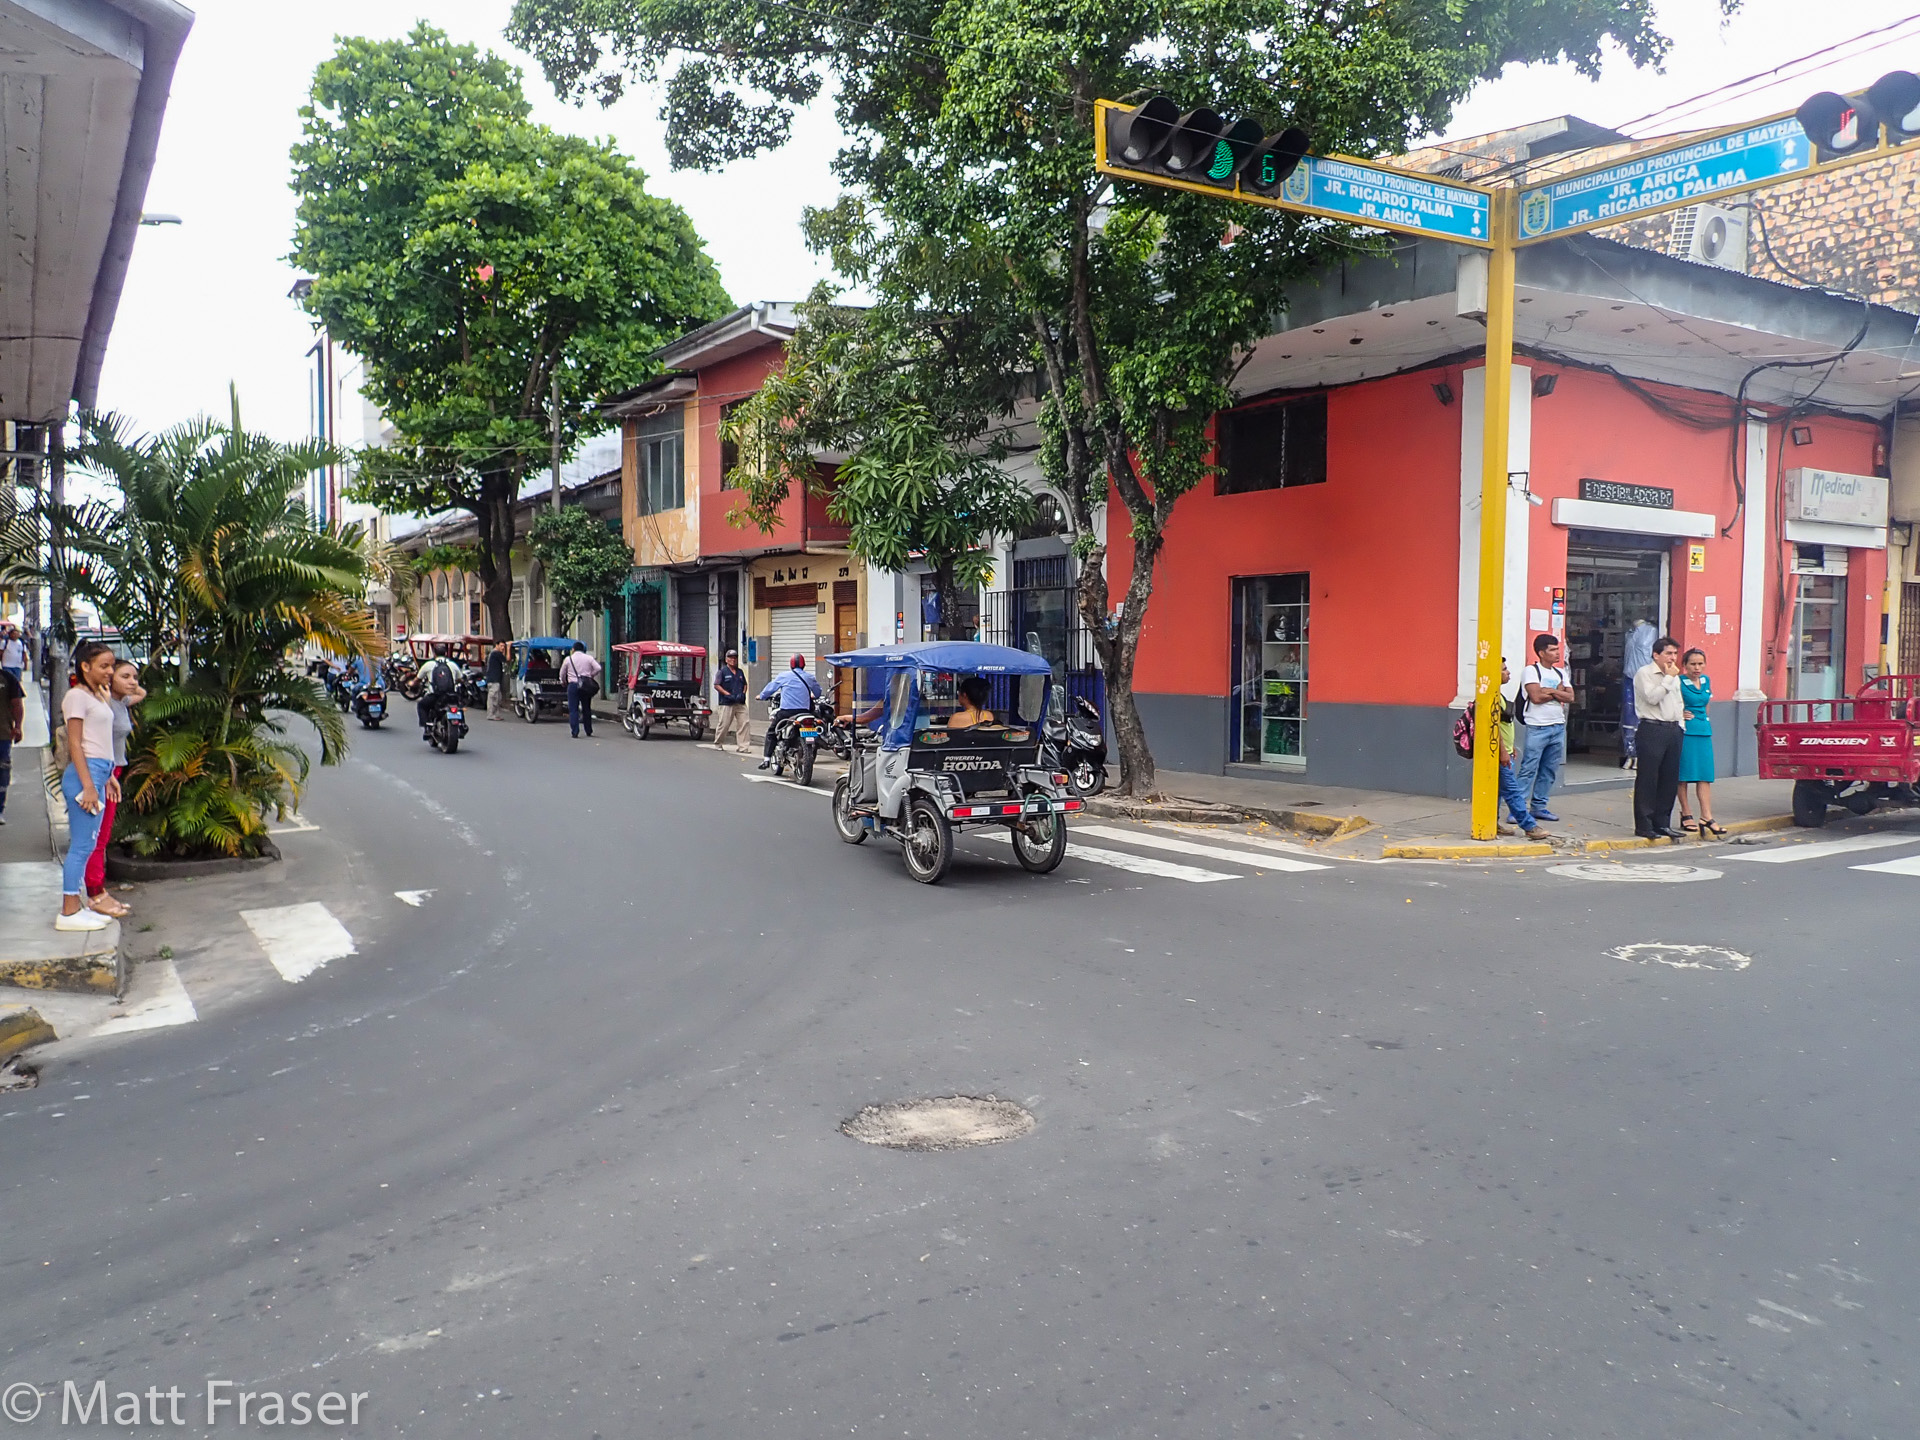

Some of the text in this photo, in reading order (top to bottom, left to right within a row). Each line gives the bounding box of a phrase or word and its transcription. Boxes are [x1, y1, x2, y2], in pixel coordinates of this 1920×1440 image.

[1316, 161, 1479, 206] MUNICIPALIDAD PROVINCIAL DE MAYNAS
[1556, 163, 1644, 197] MUNICIPALIDAD
[1647, 143, 1723, 172] PROVINCIAL
[1726, 135, 1744, 149] DE
[1608, 164, 1699, 200] JR. ARICA
[1323, 179, 1454, 218] JR. RICARDO PALMA
[1358, 202, 1422, 227] JR. ARICA
[1568, 168, 1747, 226] JR. RICARDO PALMA
[651, 689, 683, 699] 7824-2L
[1799, 737, 1869, 745] ZONGSHEN
[942, 760, 1003, 772] HONDA
